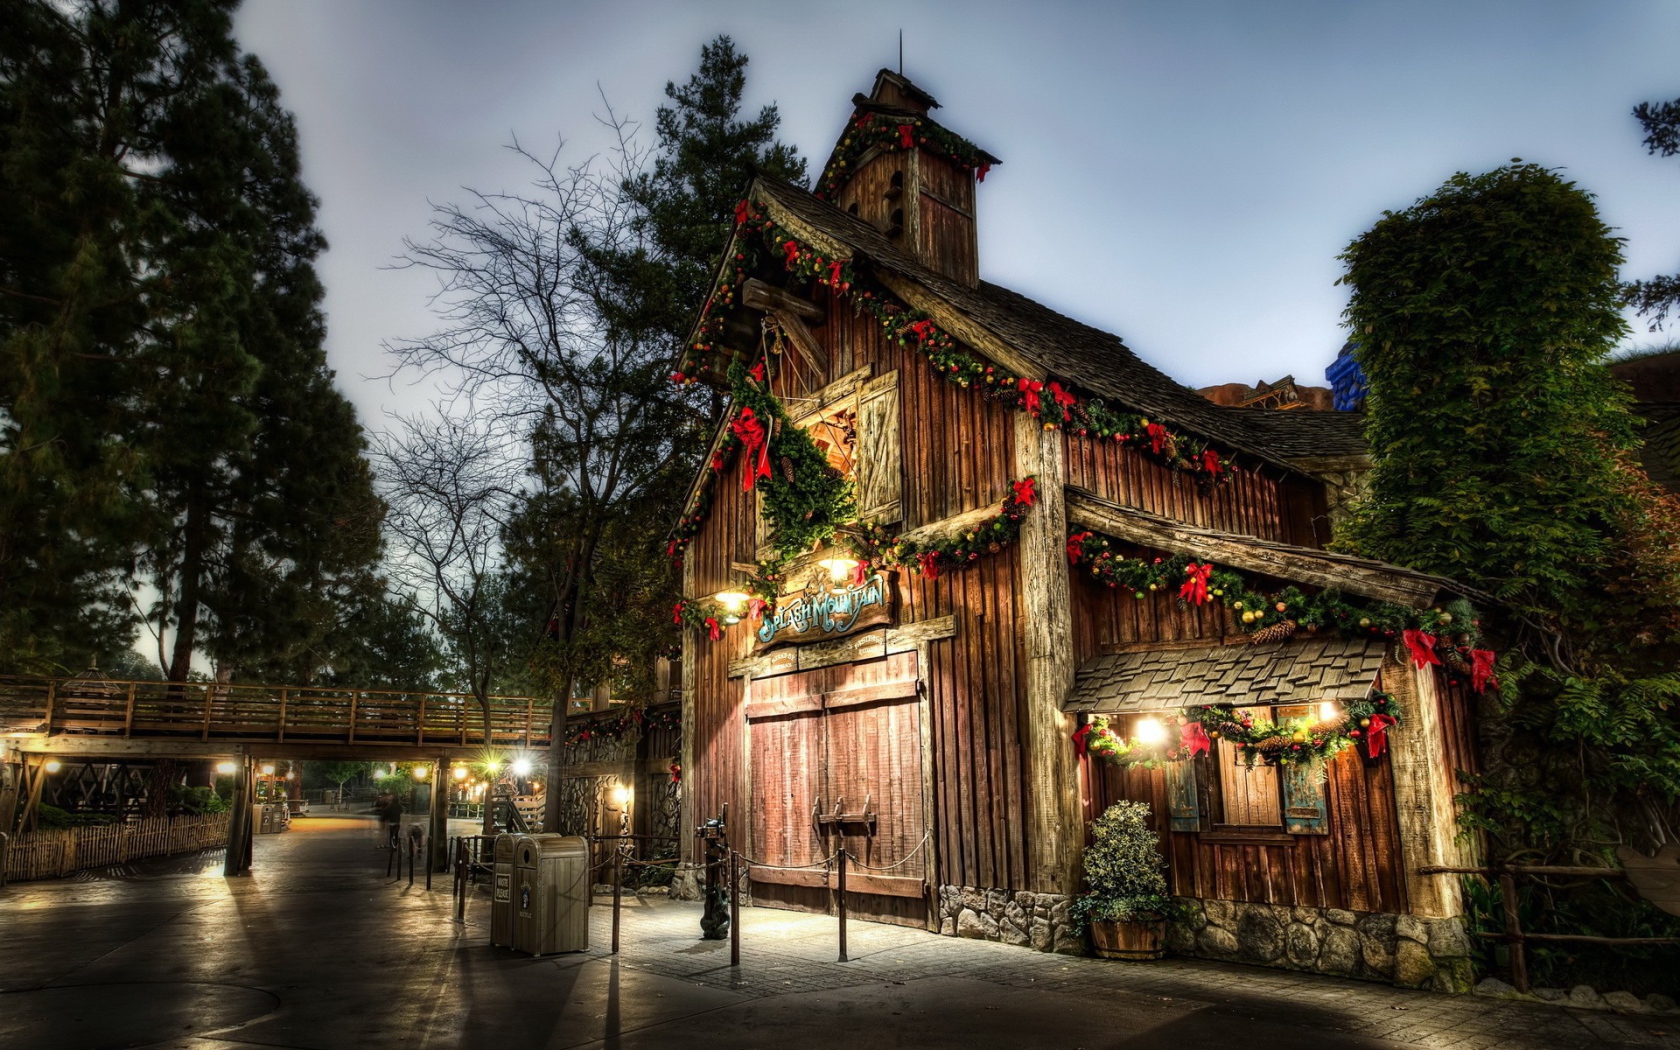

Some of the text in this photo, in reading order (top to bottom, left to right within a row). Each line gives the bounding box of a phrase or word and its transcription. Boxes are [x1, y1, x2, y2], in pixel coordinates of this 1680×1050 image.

[758, 574, 884, 642] SPLASH MOUNTAIN
[496, 888, 508, 898] PLEASE
